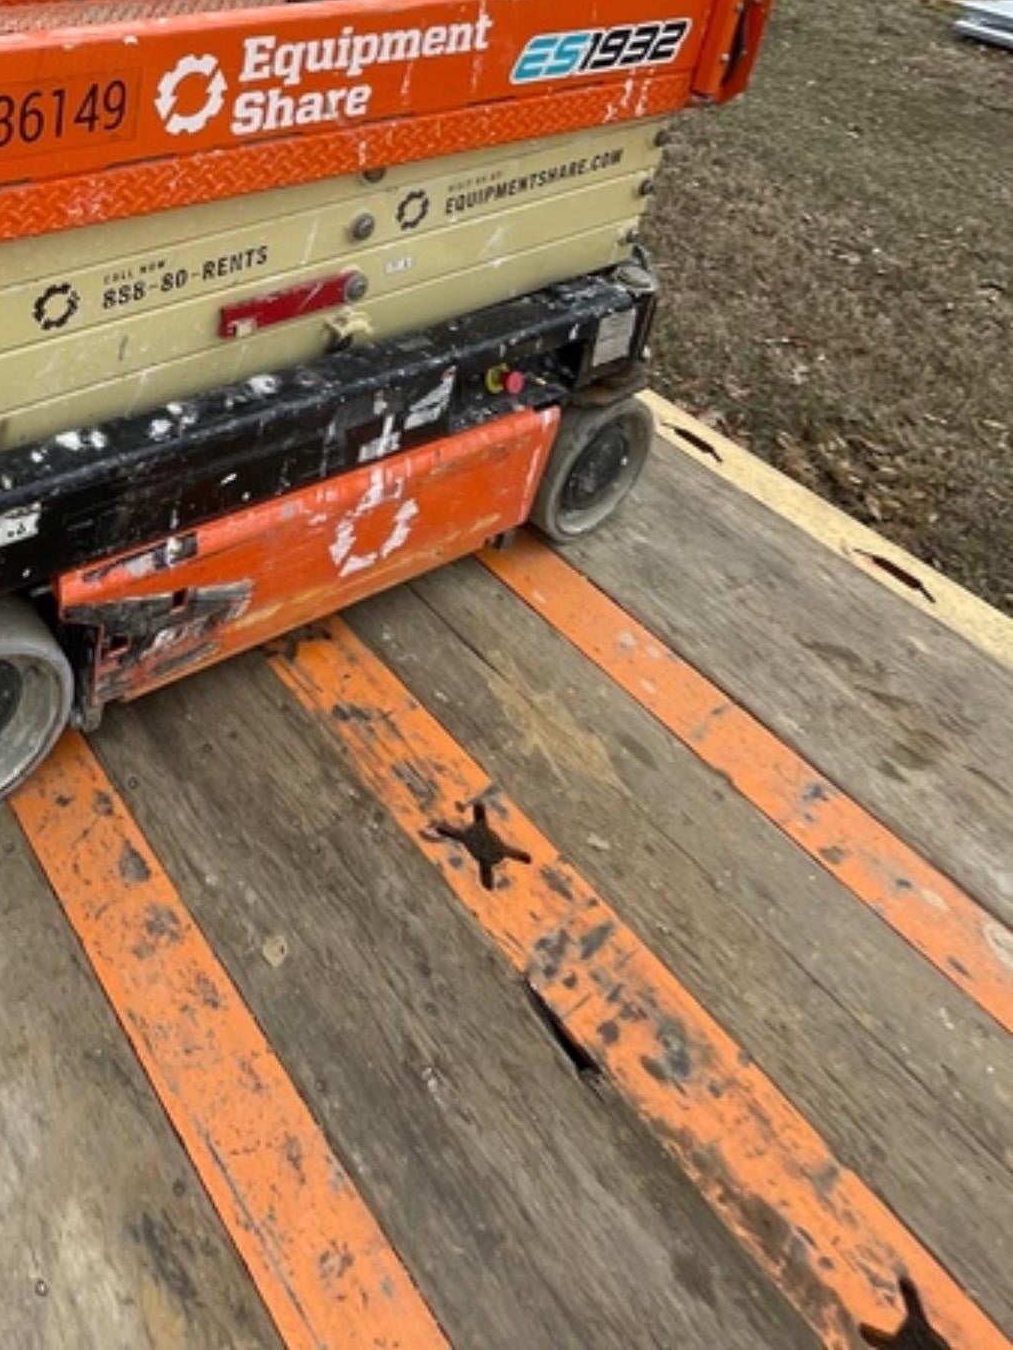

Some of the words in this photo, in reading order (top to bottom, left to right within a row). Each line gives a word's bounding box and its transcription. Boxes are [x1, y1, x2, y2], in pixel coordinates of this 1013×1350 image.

[239, 14, 493, 85] Equipment
[511, 18, 692, 84] ES1932
[231, 82, 373, 135] Share
[445, 148, 625, 215] EQUIPMENTSHARE.COM
[102, 245, 268, 310] 888-80-RENTS
